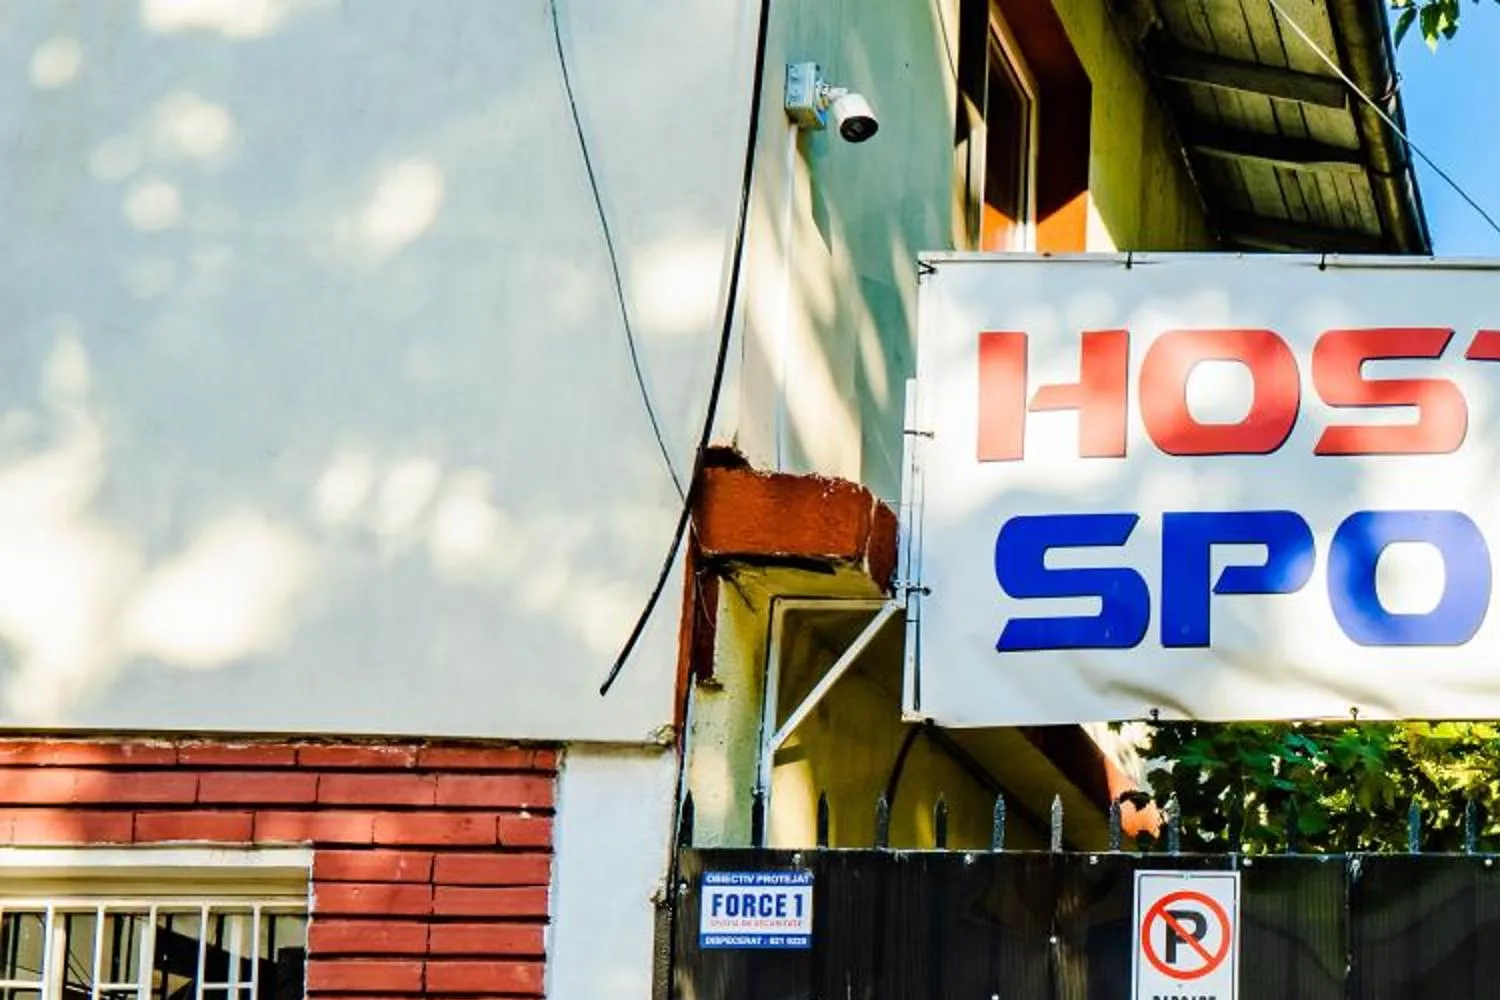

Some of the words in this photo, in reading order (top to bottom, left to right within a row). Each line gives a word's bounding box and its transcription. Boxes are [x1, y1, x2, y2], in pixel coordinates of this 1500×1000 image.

[756, 873, 810, 884] PROTEJAT
[711, 893, 787, 917] FORCE
[793, 893, 803, 917] 1
[1164, 909, 1208, 964] P
